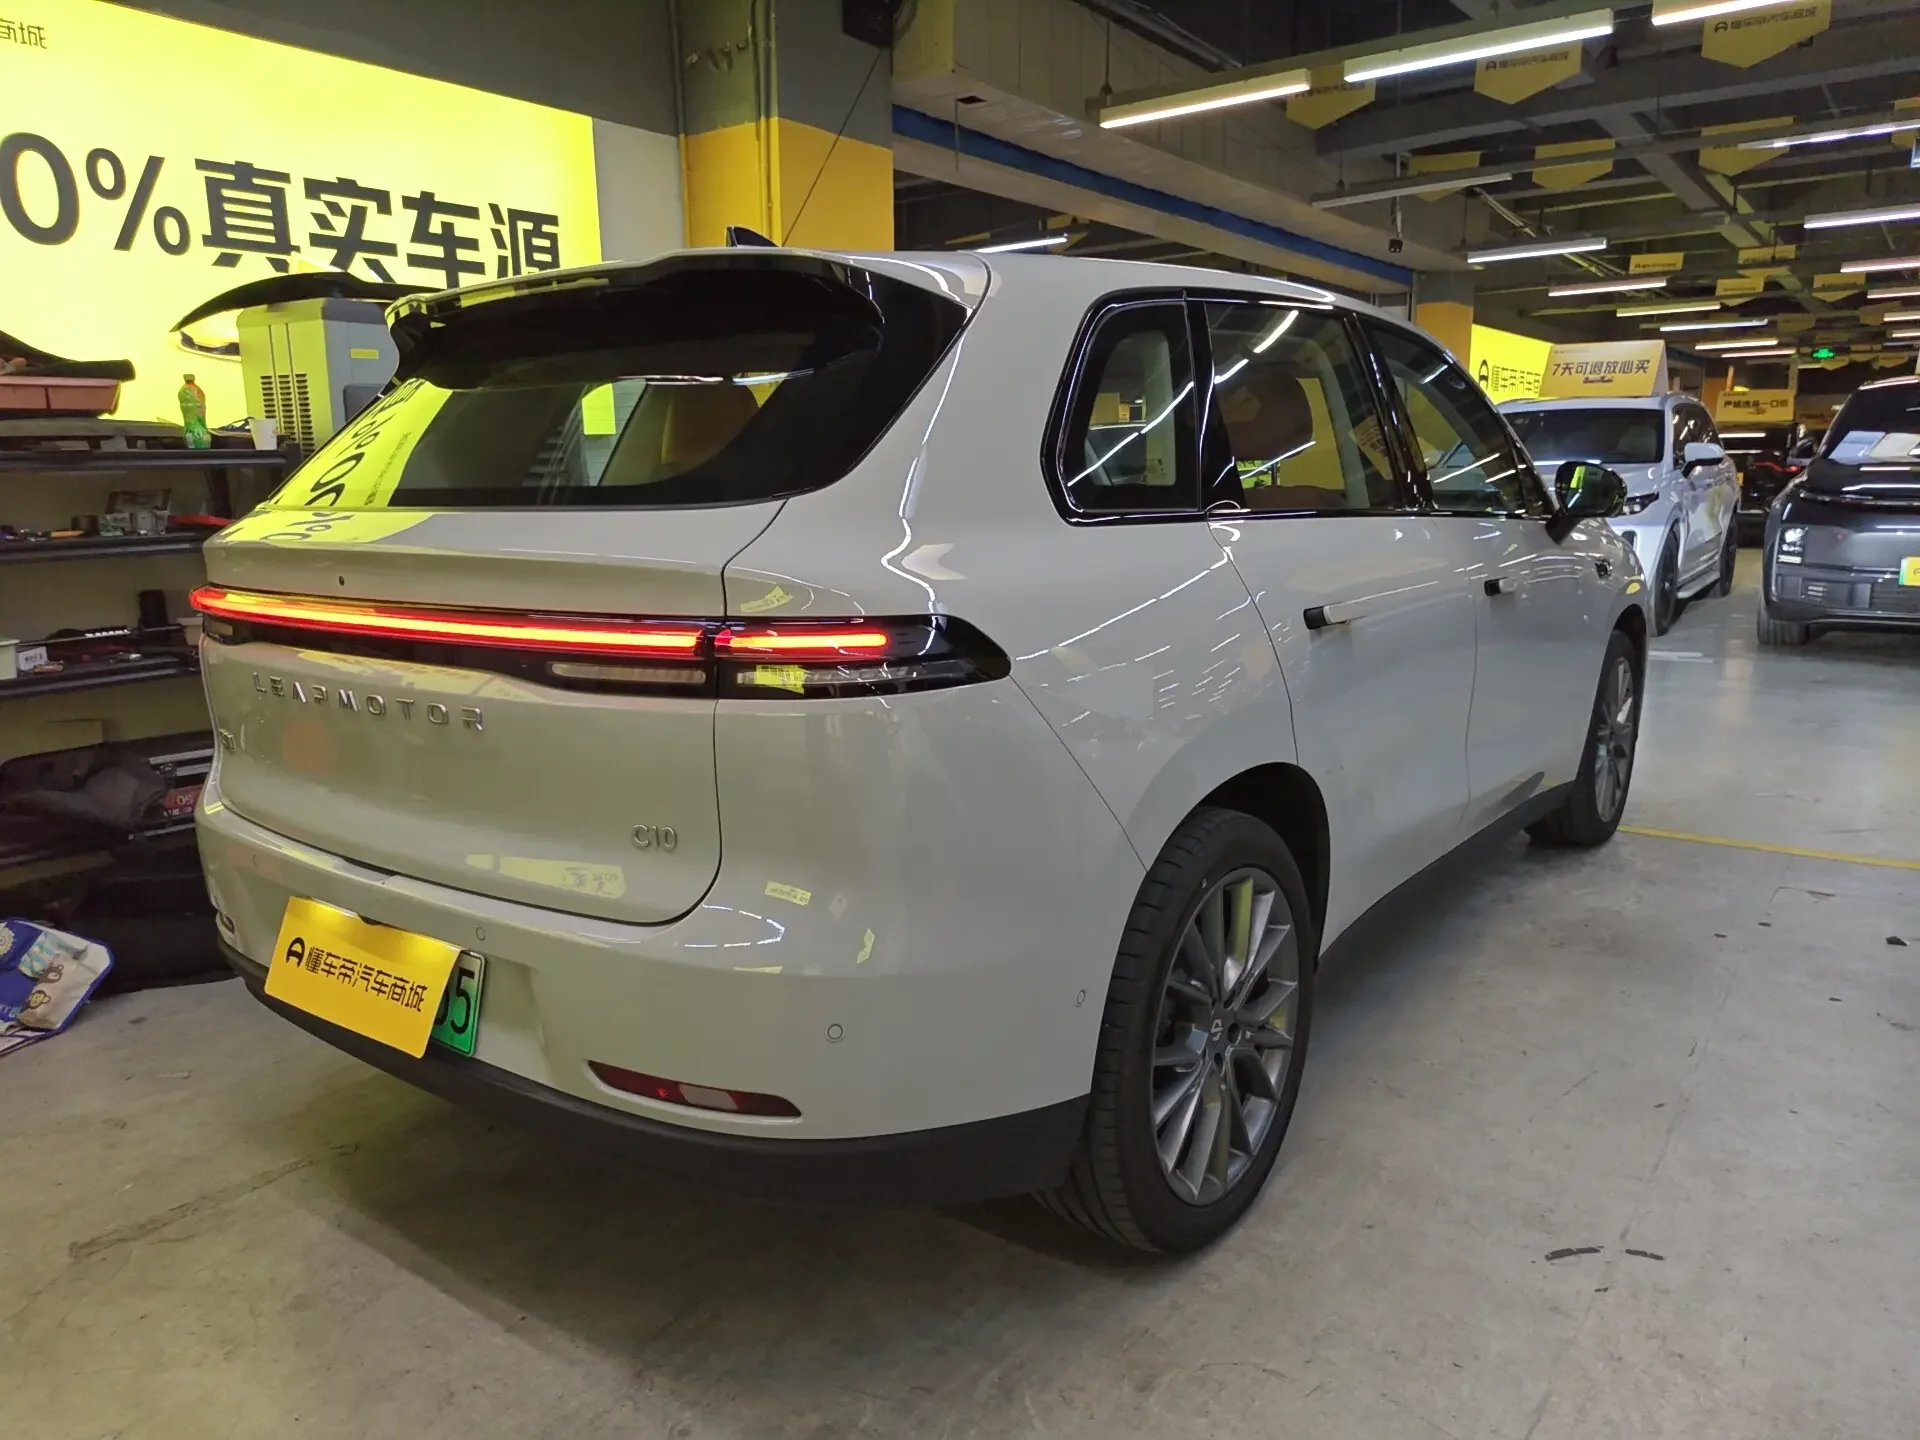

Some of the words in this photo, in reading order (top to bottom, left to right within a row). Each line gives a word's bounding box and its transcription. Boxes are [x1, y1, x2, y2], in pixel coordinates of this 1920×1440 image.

[253, 672, 484, 731] LEAPMOTOR
[631, 824, 678, 851] C10
[305, 945, 429, 1013] 懂车帝汽车商城
